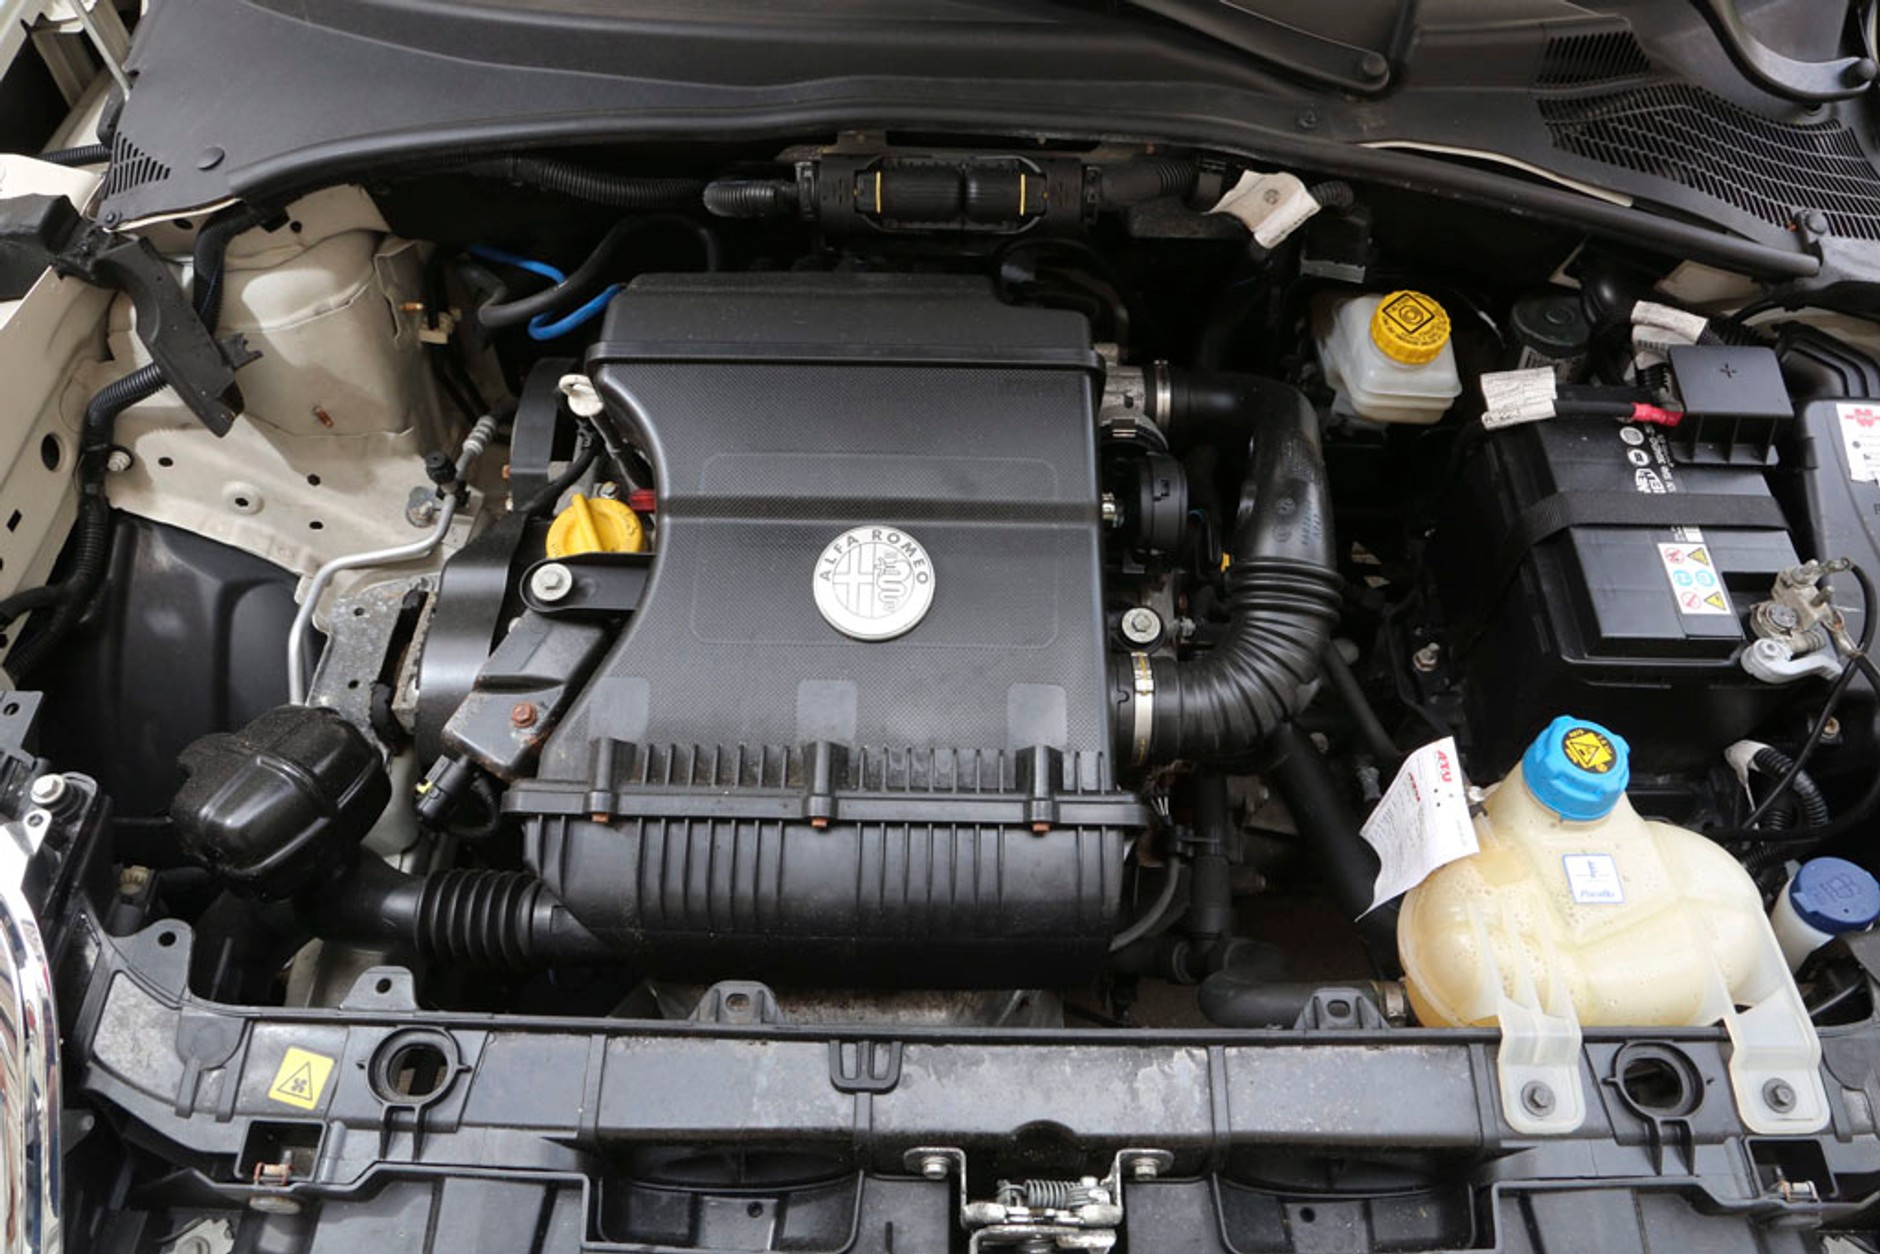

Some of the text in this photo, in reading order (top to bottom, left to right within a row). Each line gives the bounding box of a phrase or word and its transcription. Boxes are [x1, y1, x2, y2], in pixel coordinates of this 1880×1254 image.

[819, 529, 929, 585] ALFA ROMEO
[1436, 749, 1453, 783] ATU
